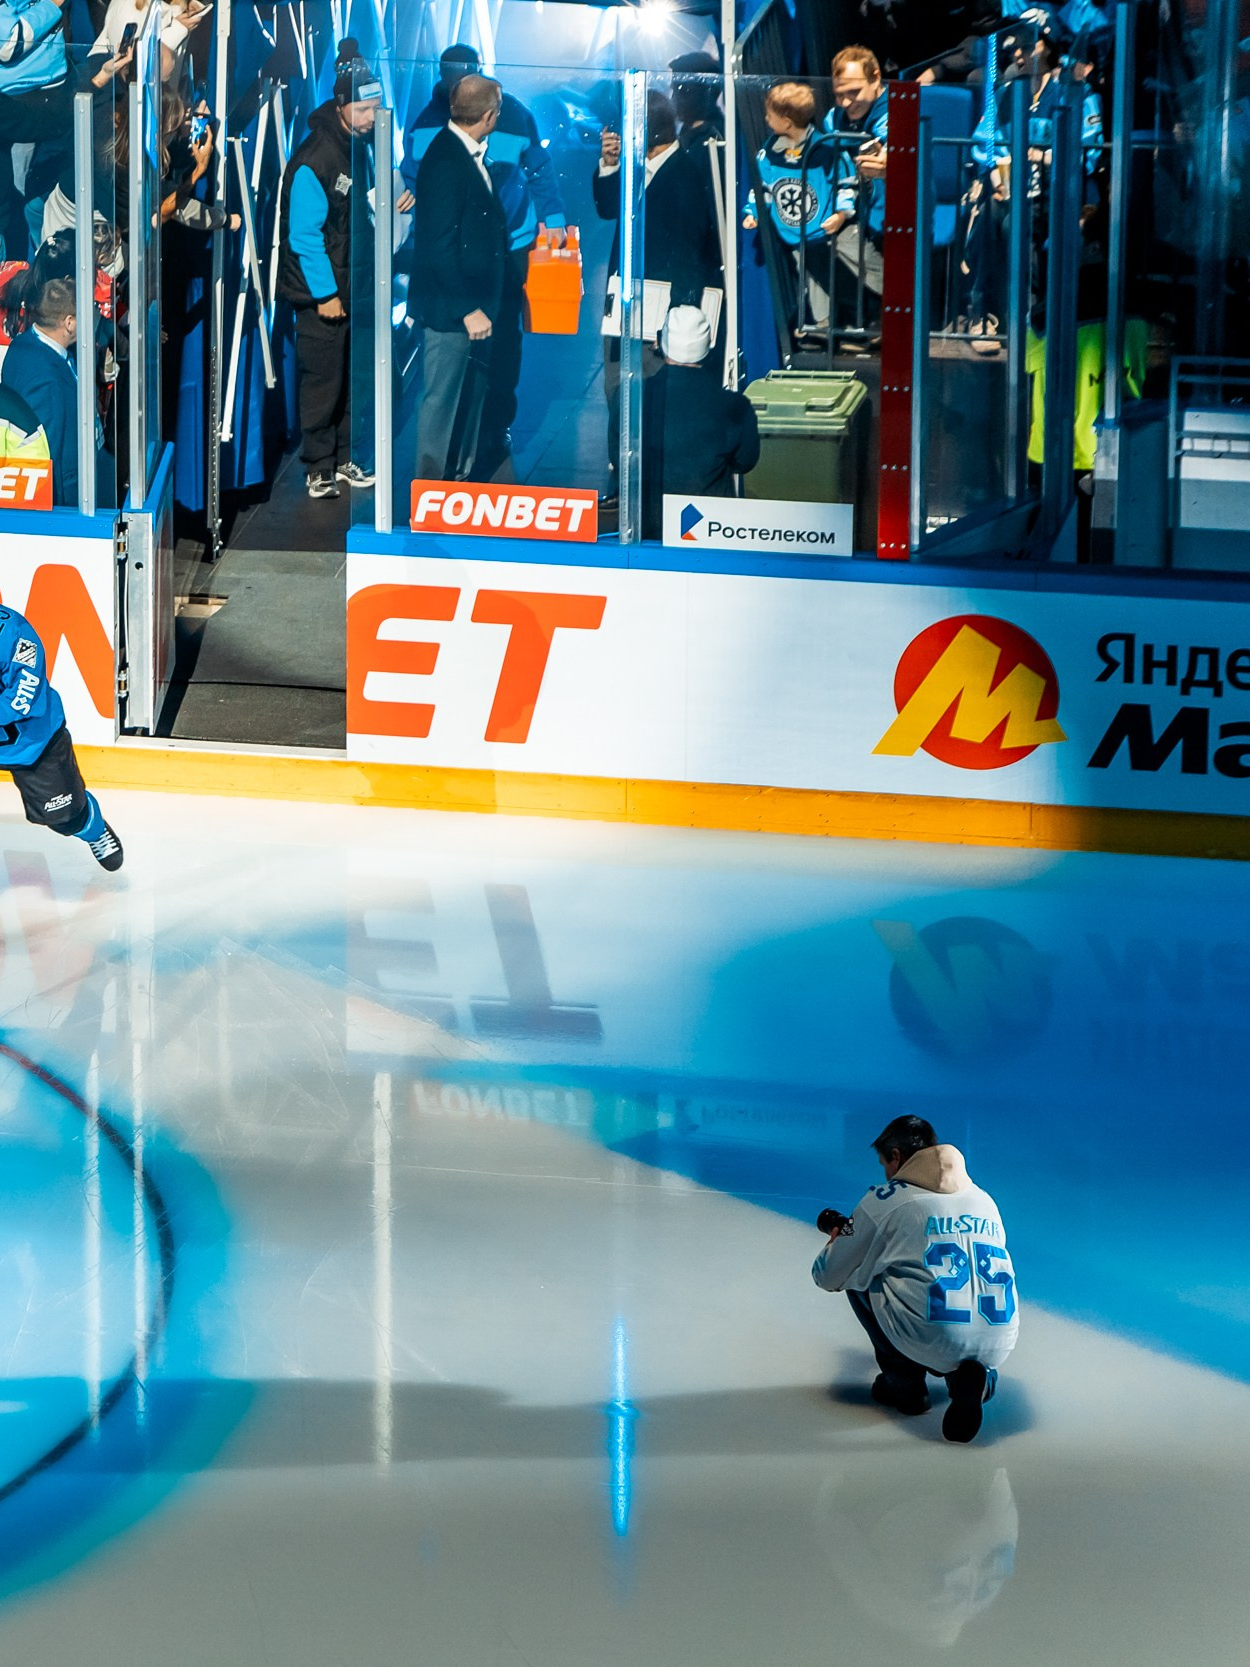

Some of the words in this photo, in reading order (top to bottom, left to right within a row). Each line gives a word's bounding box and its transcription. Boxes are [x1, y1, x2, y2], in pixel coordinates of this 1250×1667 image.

[414, 490, 594, 532] FONBET
[708, 521, 835, 544] Ростелеком
[924, 1242, 1016, 1325] 25
